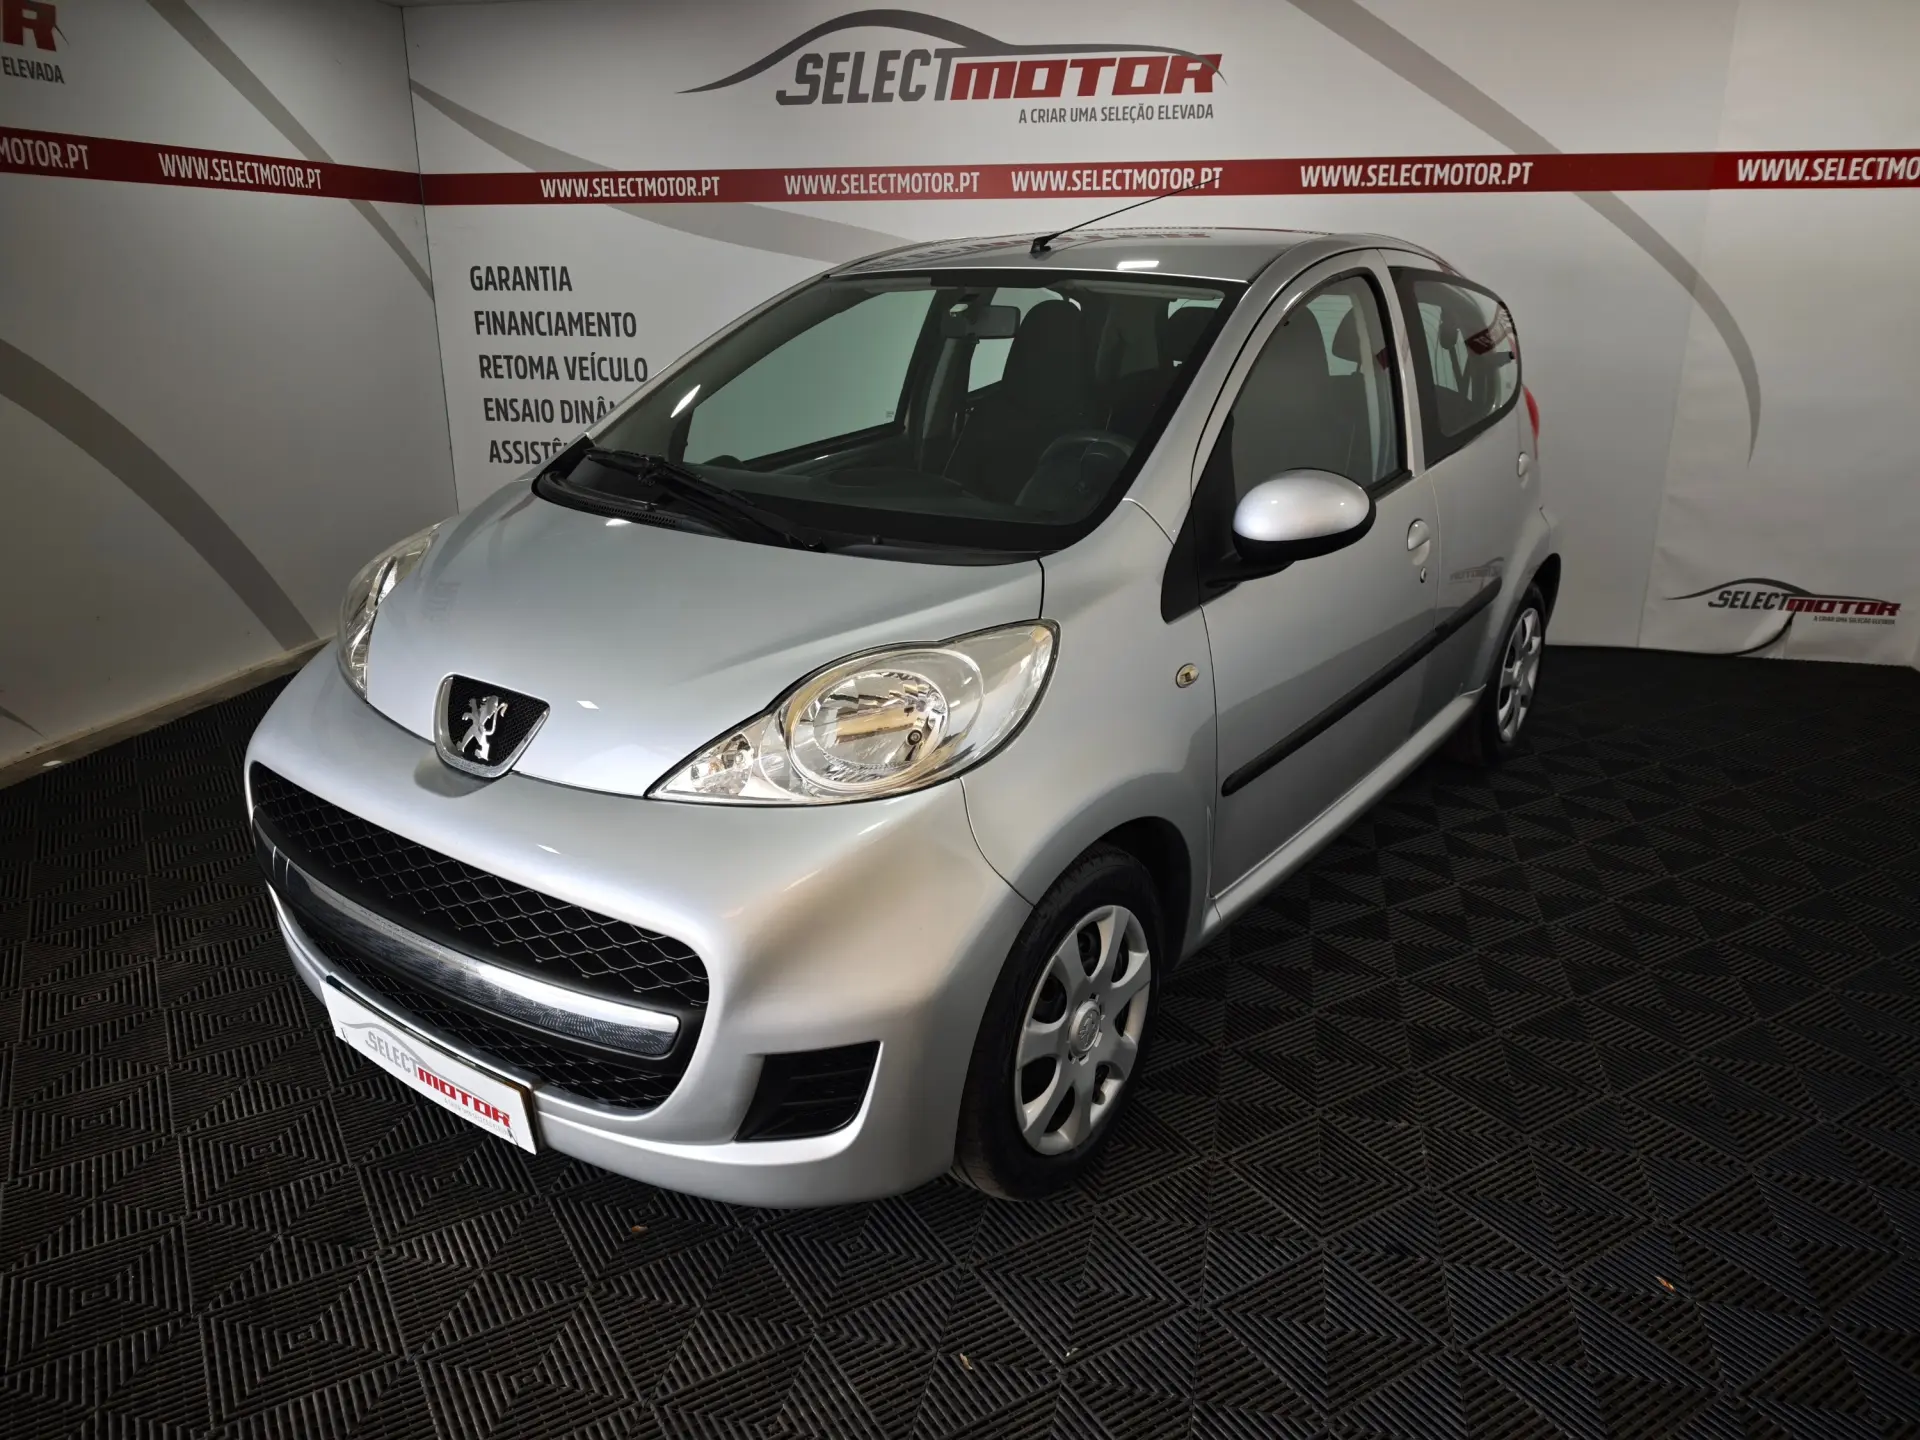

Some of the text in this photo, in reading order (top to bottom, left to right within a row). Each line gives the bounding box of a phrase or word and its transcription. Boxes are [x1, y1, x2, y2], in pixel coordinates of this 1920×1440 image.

[1, 56, 66, 84] ELEVADA
[1018, 103, 1214, 124] A CRIAR UMA SELEÇÃO ELEVADA
[158, 152, 322, 190] WWW.SELECTMOTOR.PT
[784, 171, 980, 195] WWW.SELECTMOTOR.PT
[1011, 167, 1223, 192] WWW.SELECTMOTOR.PT
[1300, 161, 1534, 187] WWW.SELECTMOTOR.PT
[540, 176, 720, 198] WWW.SELECTMOTOR.PT
[469, 265, 573, 292] GARANTIA
[474, 310, 637, 338] FINANCIAMENTO
[478, 352, 648, 383] RETOMA VEÍCULO
[483, 397, 555, 423] ENSAIO
